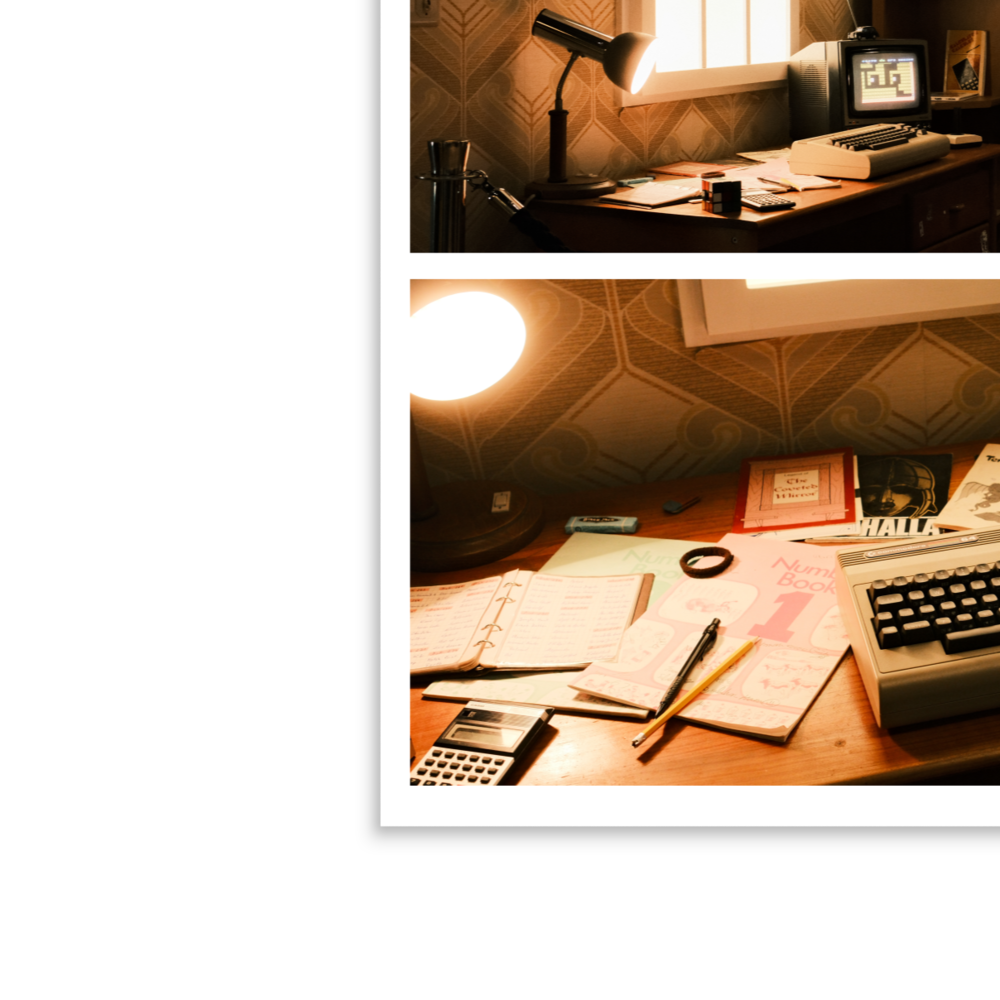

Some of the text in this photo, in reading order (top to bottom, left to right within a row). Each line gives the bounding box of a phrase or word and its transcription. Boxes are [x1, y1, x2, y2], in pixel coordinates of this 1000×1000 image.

[774, 484, 818, 492] Coveted
[776, 490, 818, 499] Mirror
[862, 518, 940, 536] HALLA
[776, 572, 836, 595] Book
[747, 591, 815, 643] 1
